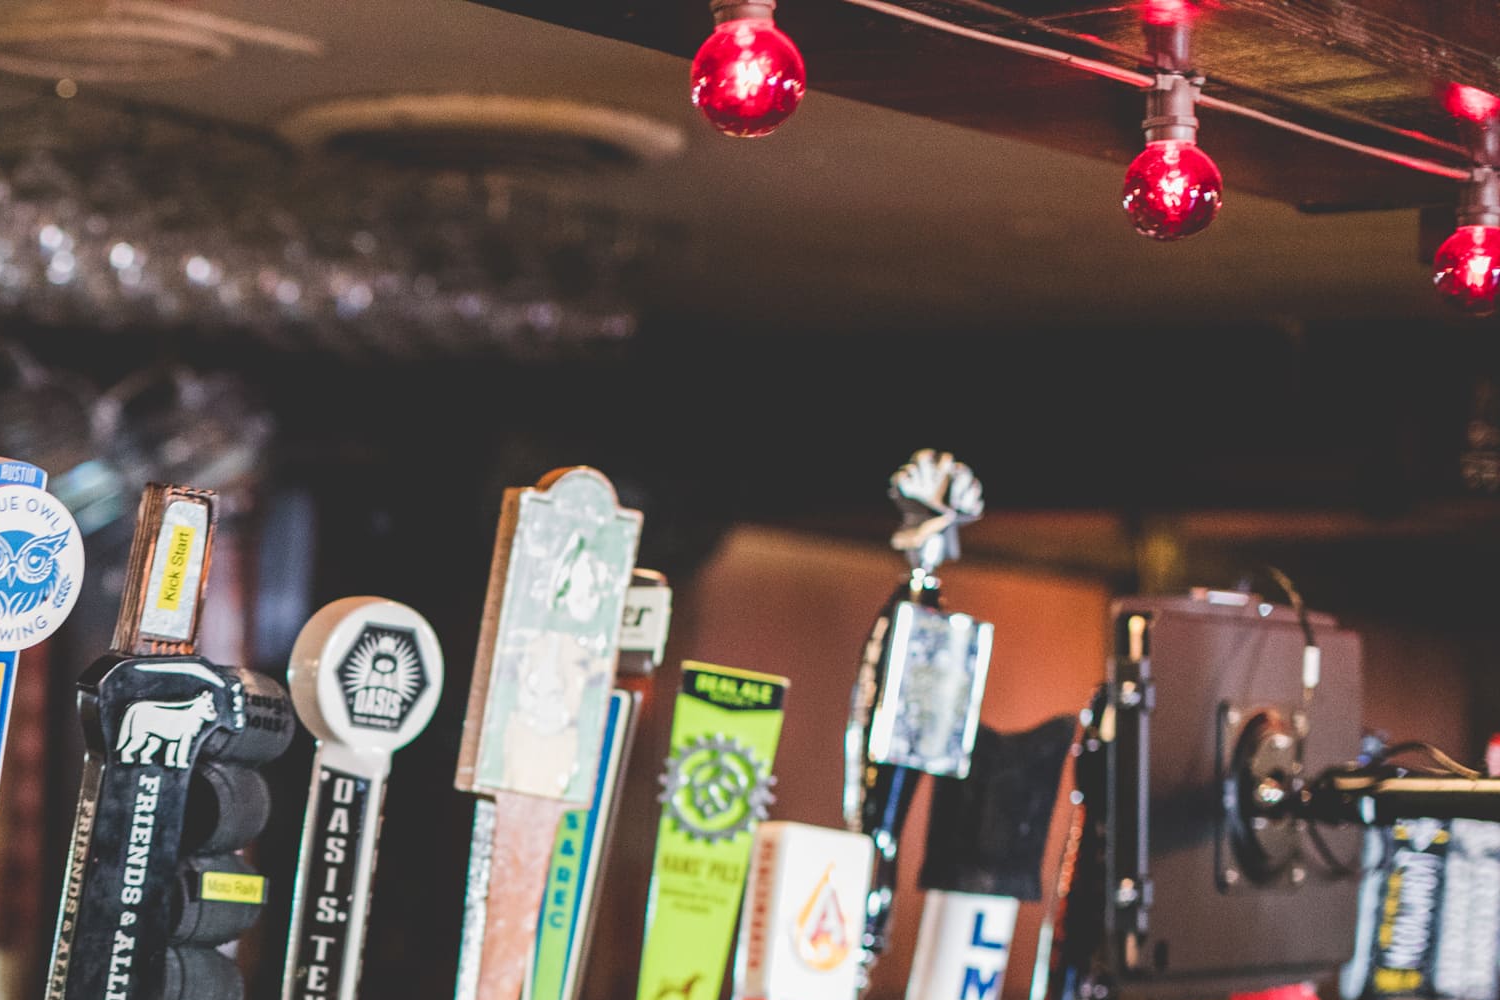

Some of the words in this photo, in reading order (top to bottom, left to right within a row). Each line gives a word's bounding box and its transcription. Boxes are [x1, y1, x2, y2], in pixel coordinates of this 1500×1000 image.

[0, 464, 37, 483] AUSTIN
[25, 498, 63, 532] OWL
[170, 531, 191, 572] Start
[163, 572, 181, 602] Kick
[353, 687, 404, 719] OASIS
[121, 774, 161, 905] FRIENDS
[65, 799, 95, 914] FRIENDS
[119, 911, 137, 926] &
